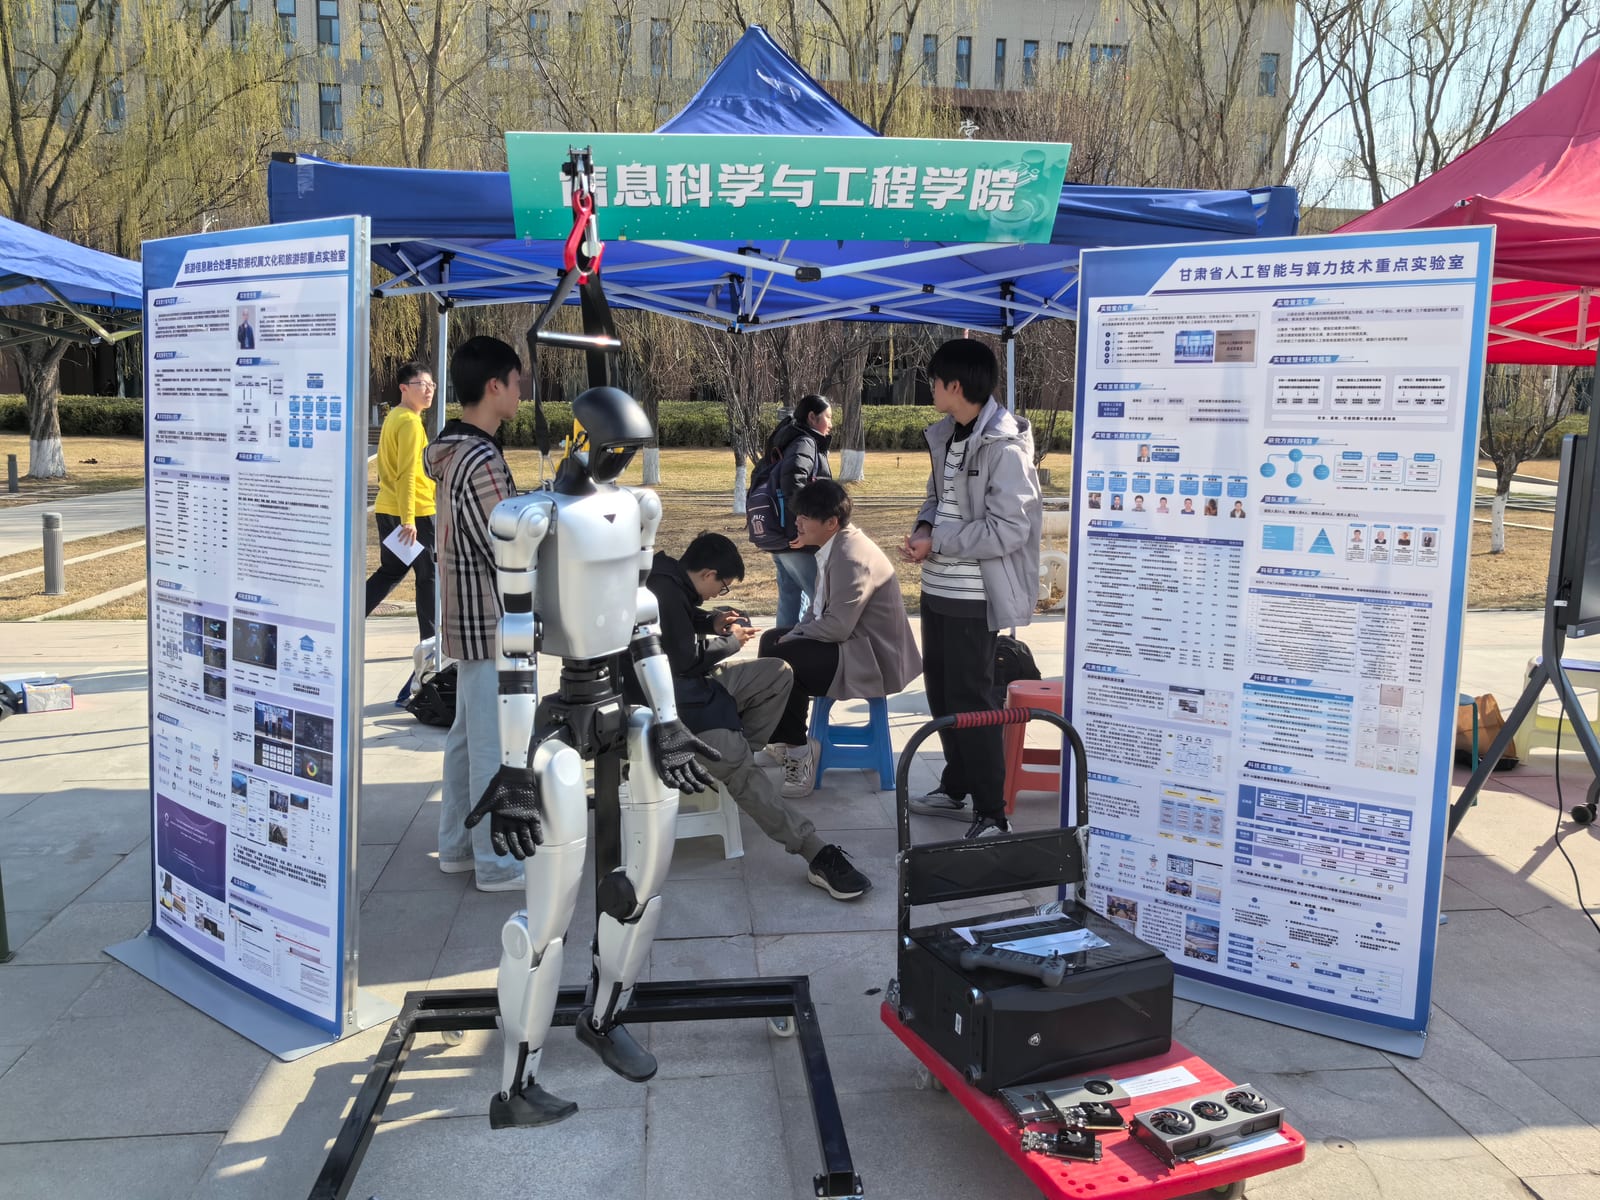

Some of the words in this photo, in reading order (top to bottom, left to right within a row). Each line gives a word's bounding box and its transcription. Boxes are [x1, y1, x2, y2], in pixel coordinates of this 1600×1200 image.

[1179, 254, 1465, 282] 甘肃省人工智能与算力技术重点实验室
